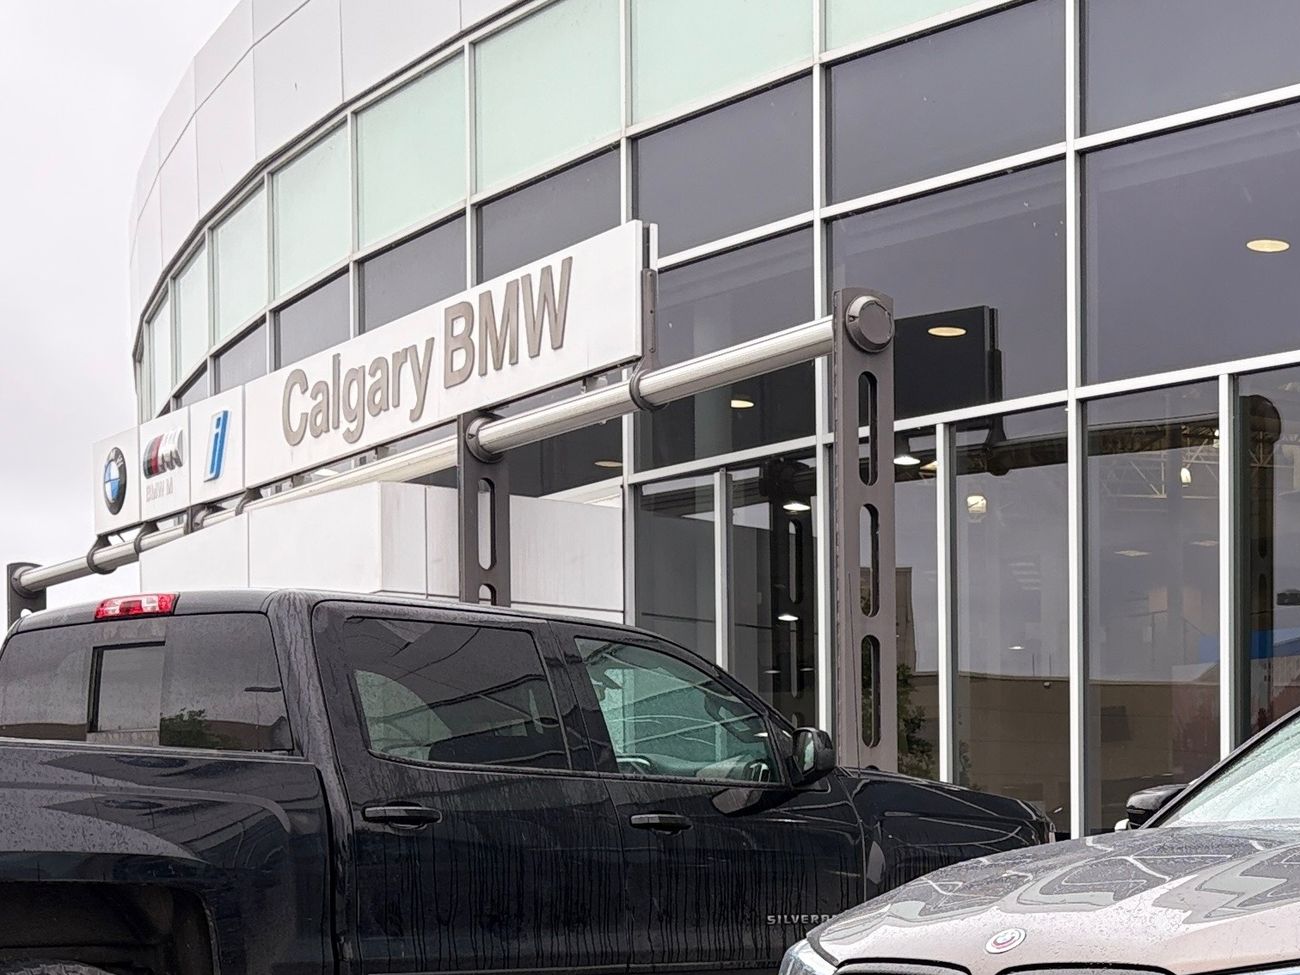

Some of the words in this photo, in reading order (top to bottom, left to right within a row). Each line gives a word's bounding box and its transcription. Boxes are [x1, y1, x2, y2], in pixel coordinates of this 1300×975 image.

[282, 337, 435, 446] Calgary
[444, 256, 573, 389] BMW
[767, 914, 837, 924] SILVERA
